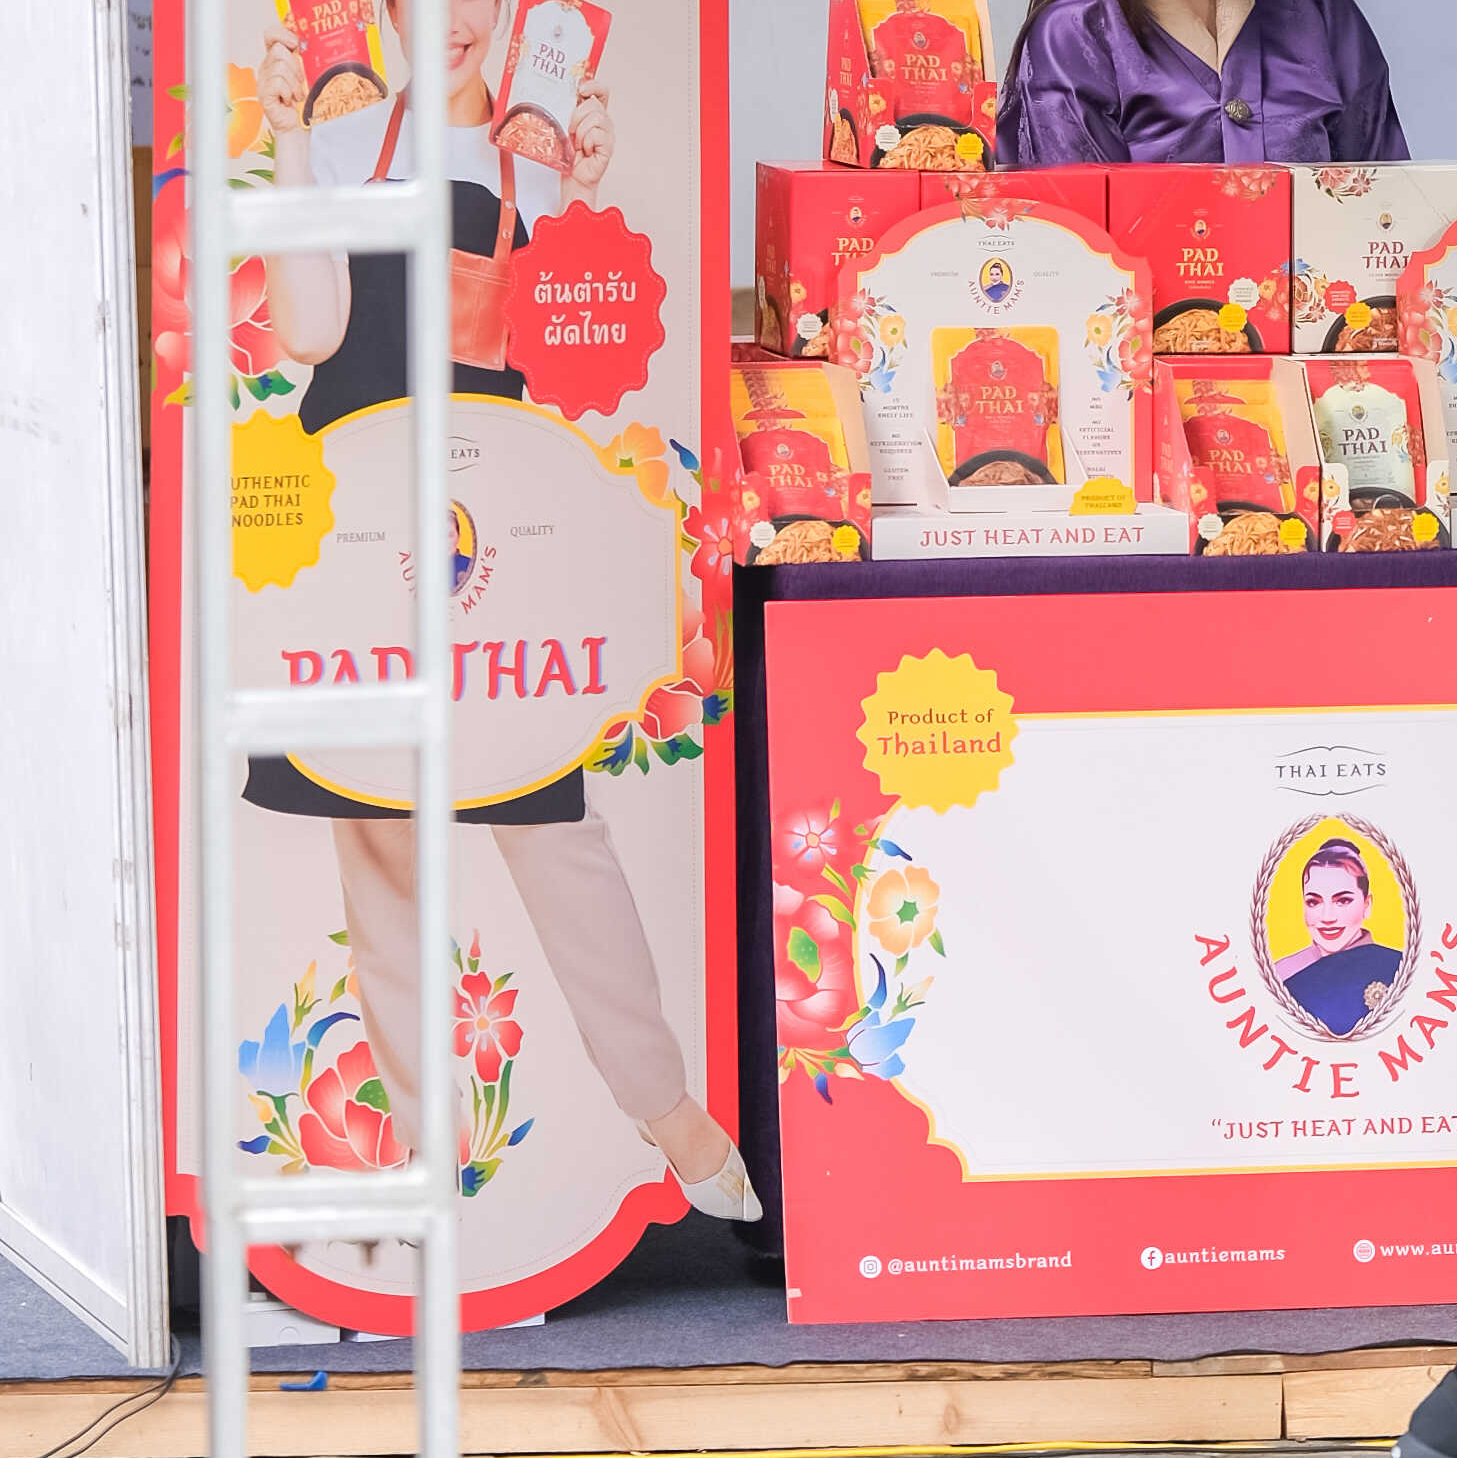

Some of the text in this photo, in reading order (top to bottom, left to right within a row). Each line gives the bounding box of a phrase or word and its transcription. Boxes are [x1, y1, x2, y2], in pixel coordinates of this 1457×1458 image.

[312, 0, 342, 20] PAD
[311, 11, 349, 34] THAI
[540, 43, 566, 64] PAD
[904, 54, 941, 68] PAD
[532, 54, 567, 80] THAI
[900, 67, 948, 81] THAI
[836, 237, 875, 252] PAD
[1367, 241, 1405, 256] PAD
[1181, 247, 1220, 262] PAD
[1361, 255, 1409, 270] THAI
[1176, 262, 1225, 277] THAI
[534, 270, 637, 304] ต้นตำรับ
[968, 280, 1000, 315] AUNTIE
[544, 310, 627, 346] ผัดไทย
[980, 385, 1017, 400] PAD
[975, 399, 1024, 414] THAI
[1342, 427, 1381, 442] PAD
[450, 448, 481, 459] EATS
[1208, 449, 1246, 462] PAD
[1337, 441, 1388, 456] THAI
[767, 463, 806, 476] PAD
[1206, 461, 1253, 475] THAI
[230, 474, 311, 491] UTHENTIC
[764, 475, 814, 488] THAI
[230, 494, 301, 509] PAD THAI
[231, 512, 304, 528] NOODLES
[336, 525, 555, 544] PREMIUM QUALITY
[920, 526, 1145, 547] JUST HEAT AND EAT
[461, 545, 497, 615] MAM'S
[450, 636, 609, 702] THAI
[887, 707, 996, 725] Product of
[876, 730, 1001, 759] Thailand
[1275, 762, 1387, 779] THAI EATS
[1194, 932, 1361, 1100] AUNTIE
[1292, 1117, 1357, 1138] HEAT
[1364, 1116, 1413, 1136] AND
[887, 1250, 1073, 1276] @auntimamsbrand
[1163, 1246, 1287, 1265] auntiemams
